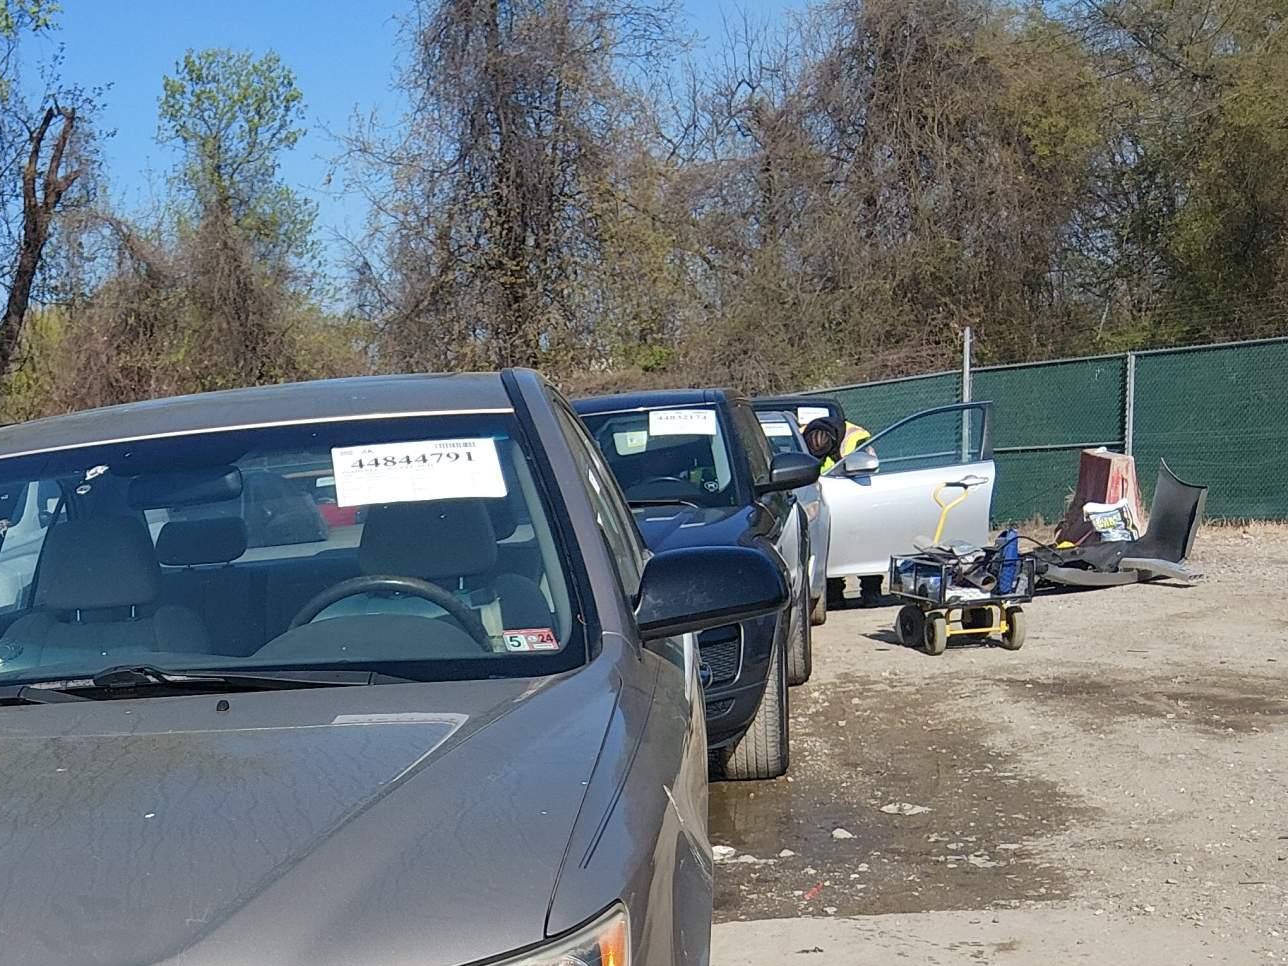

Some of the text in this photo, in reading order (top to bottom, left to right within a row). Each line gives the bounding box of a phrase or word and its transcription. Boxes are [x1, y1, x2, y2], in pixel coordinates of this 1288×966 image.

[351, 451, 475, 469] 44844791
[509, 636, 521, 648] 5
[537, 633, 553, 643] 24
